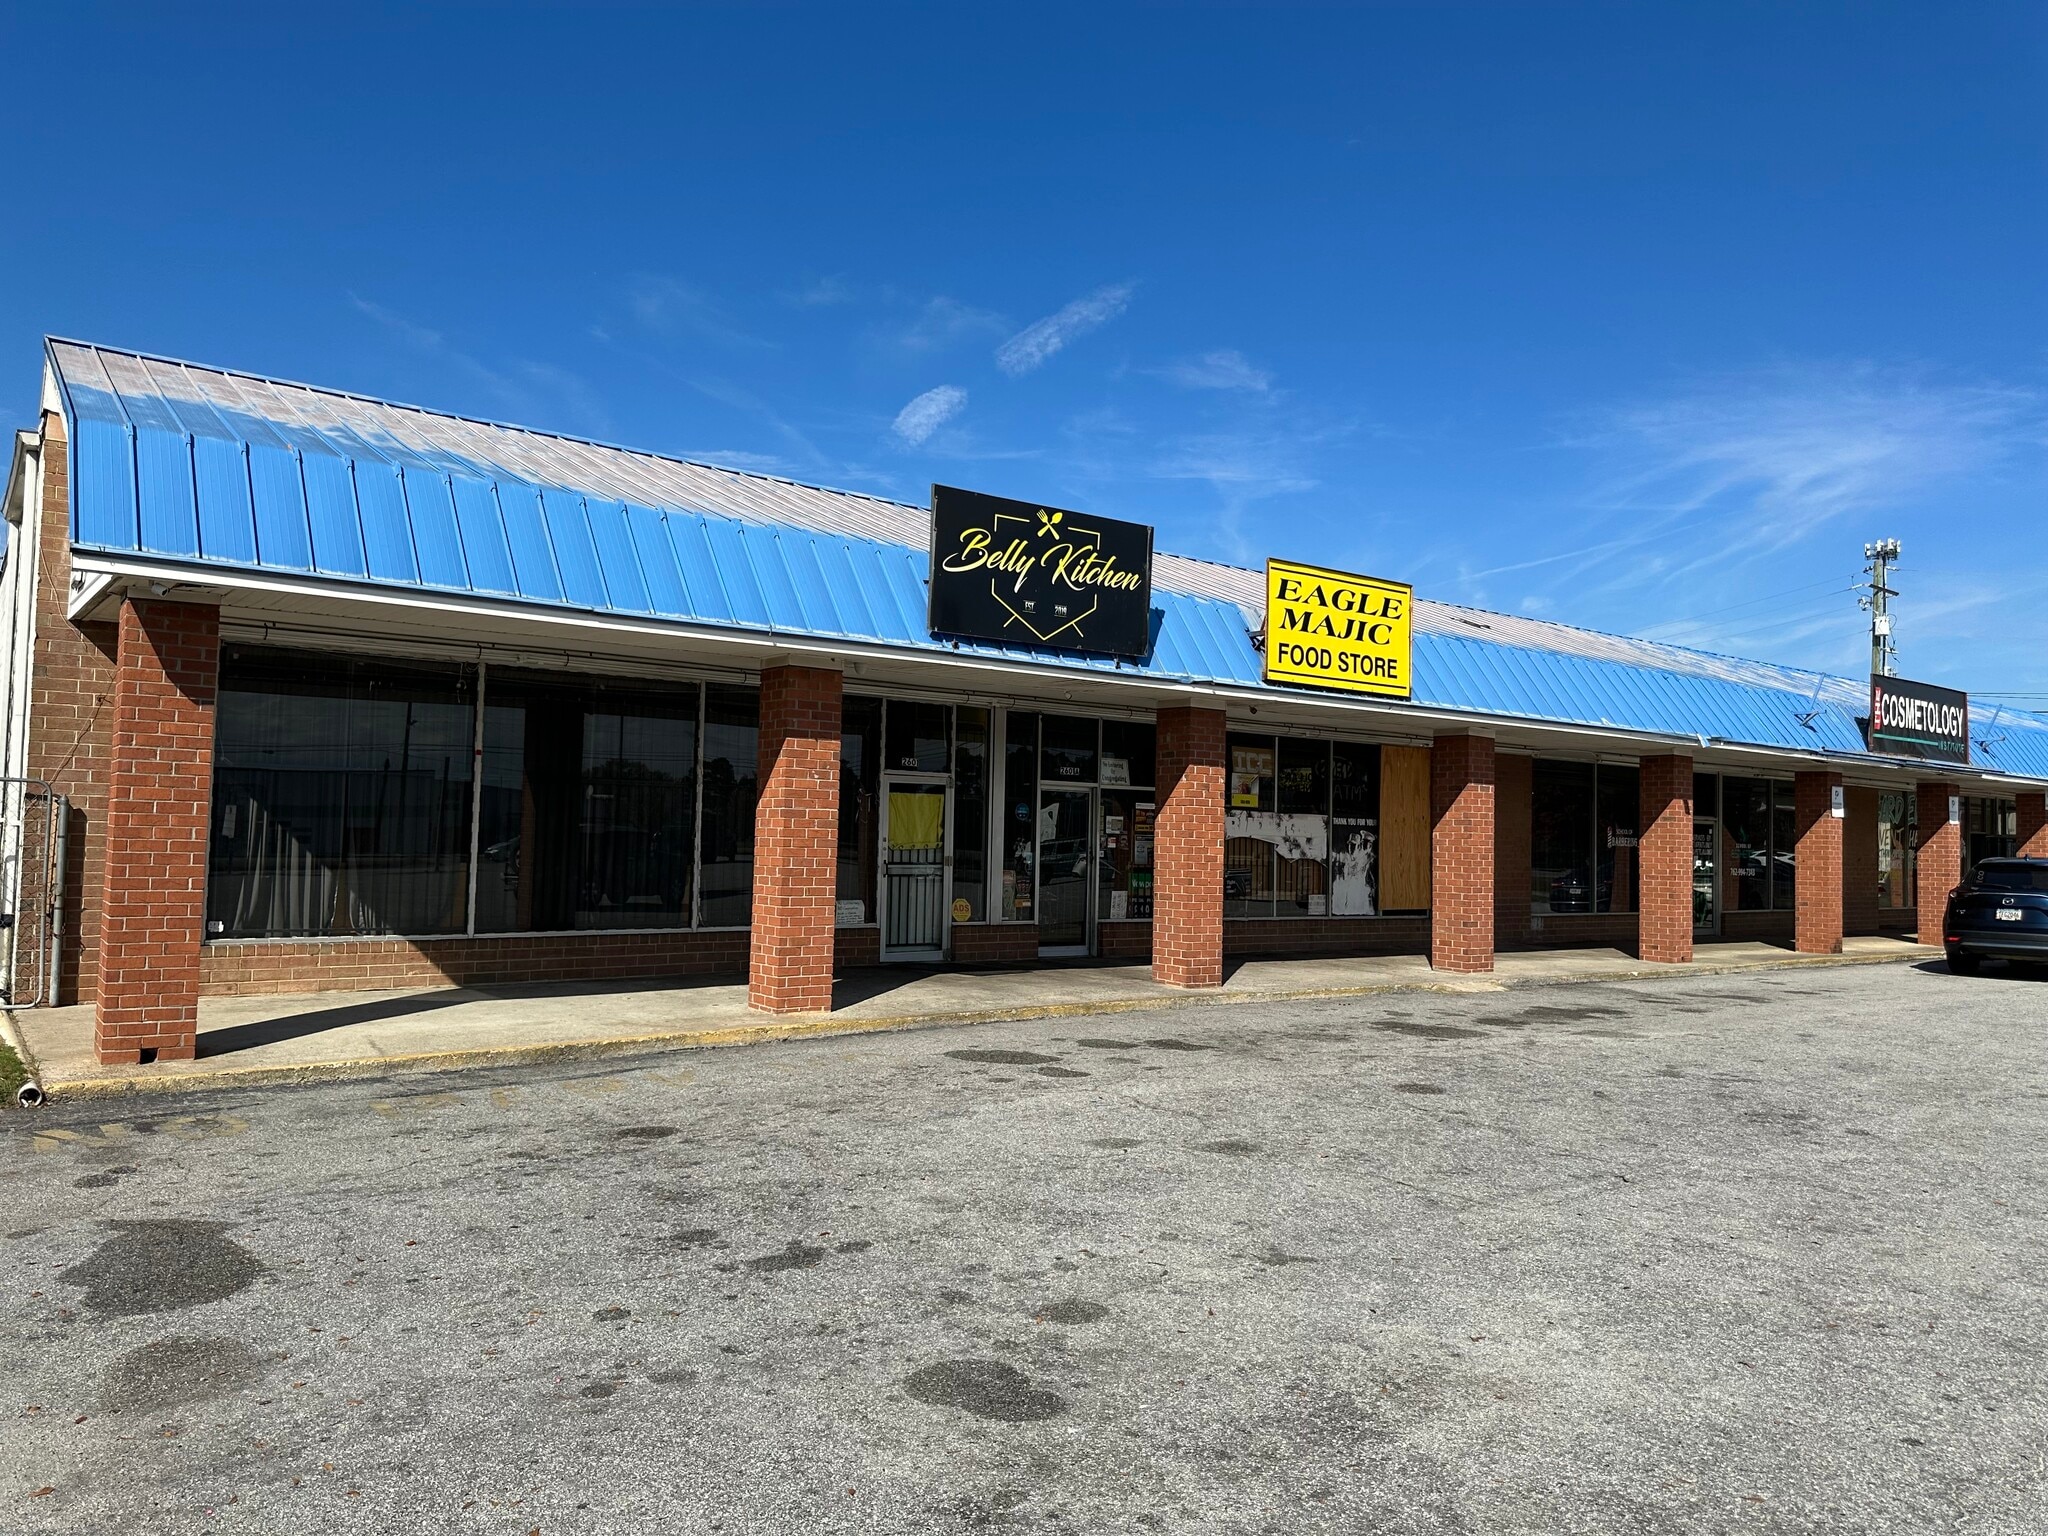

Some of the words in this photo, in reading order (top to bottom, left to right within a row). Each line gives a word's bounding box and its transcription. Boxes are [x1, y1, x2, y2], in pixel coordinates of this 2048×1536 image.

[942, 528, 1036, 593] Belly
[1040, 543, 1141, 591] Kitchen
[1025, 601, 1035, 612] EST
[1054, 605, 1068, 616] 2019
[1276, 578, 1402, 620] EAGLE
[1279, 607, 1393, 645] MAJIC
[1278, 642, 1332, 670] FOOD
[1338, 651, 1398, 679] STORE
[1881, 693, 1963, 738] COSMETOLOGY
[1938, 740, 1965, 754] INSTITUTE
[1333, 817, 1347, 825] THANK
[1348, 818, 1356, 826] YOU
[1357, 818, 1365, 826] FOR
[953, 904, 970, 912] ADS
